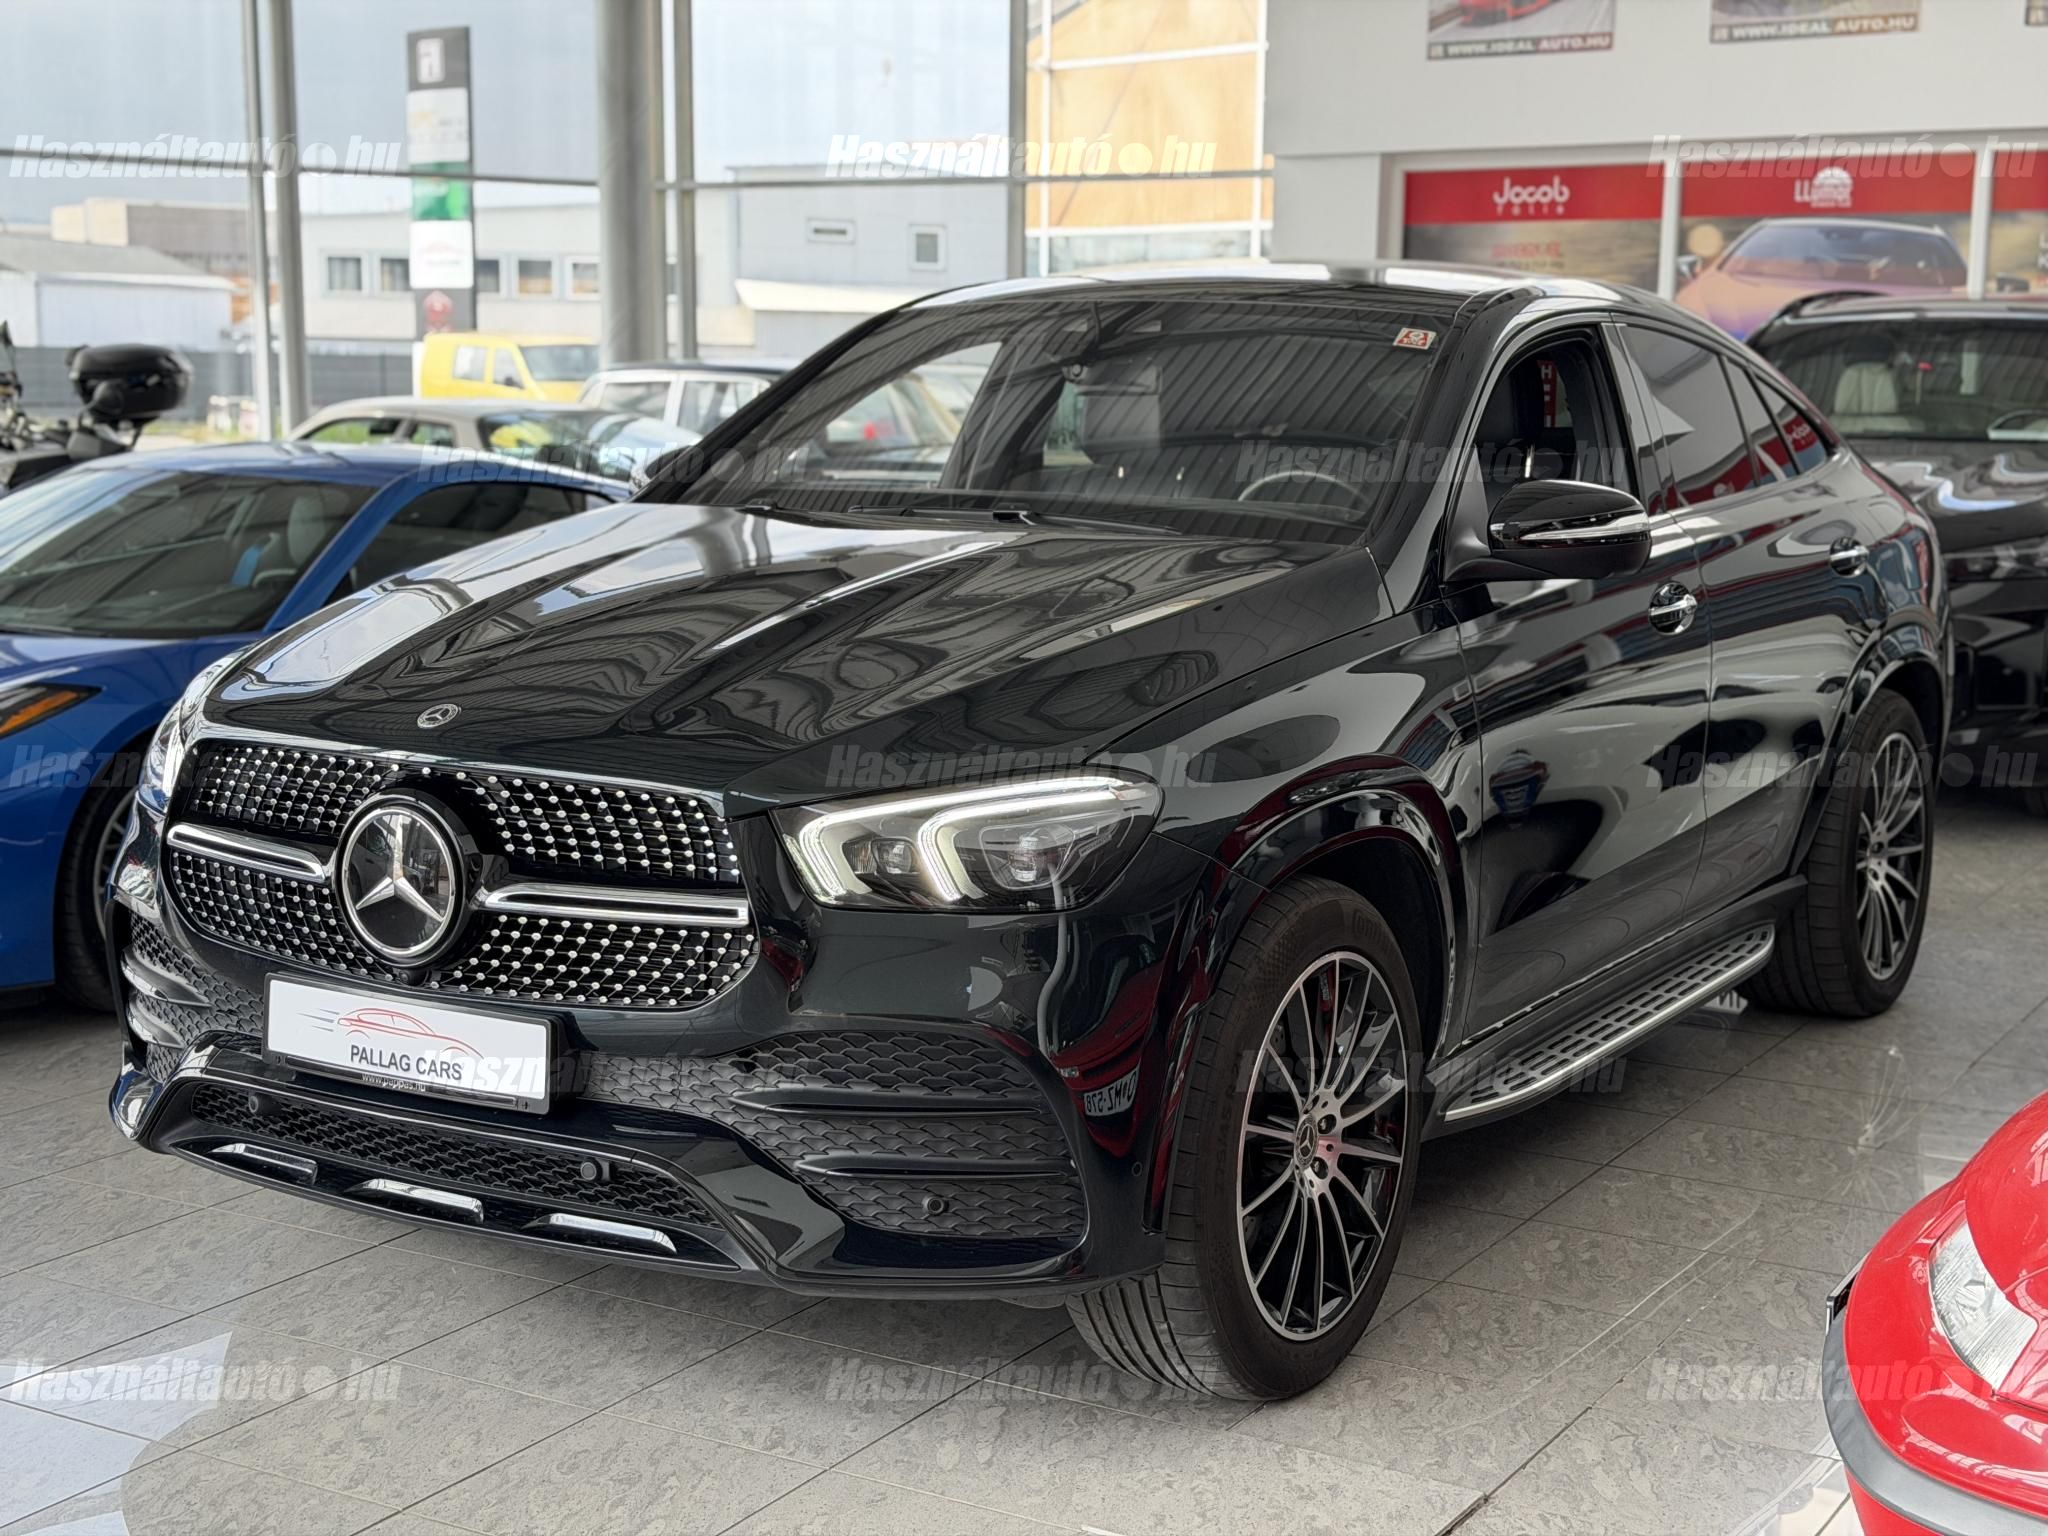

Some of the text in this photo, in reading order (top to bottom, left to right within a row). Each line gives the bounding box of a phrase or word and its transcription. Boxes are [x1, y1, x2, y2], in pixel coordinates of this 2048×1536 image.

[1492, 175, 1570, 205] Jacob
[351, 1044, 463, 1081] PALLAG CARS
